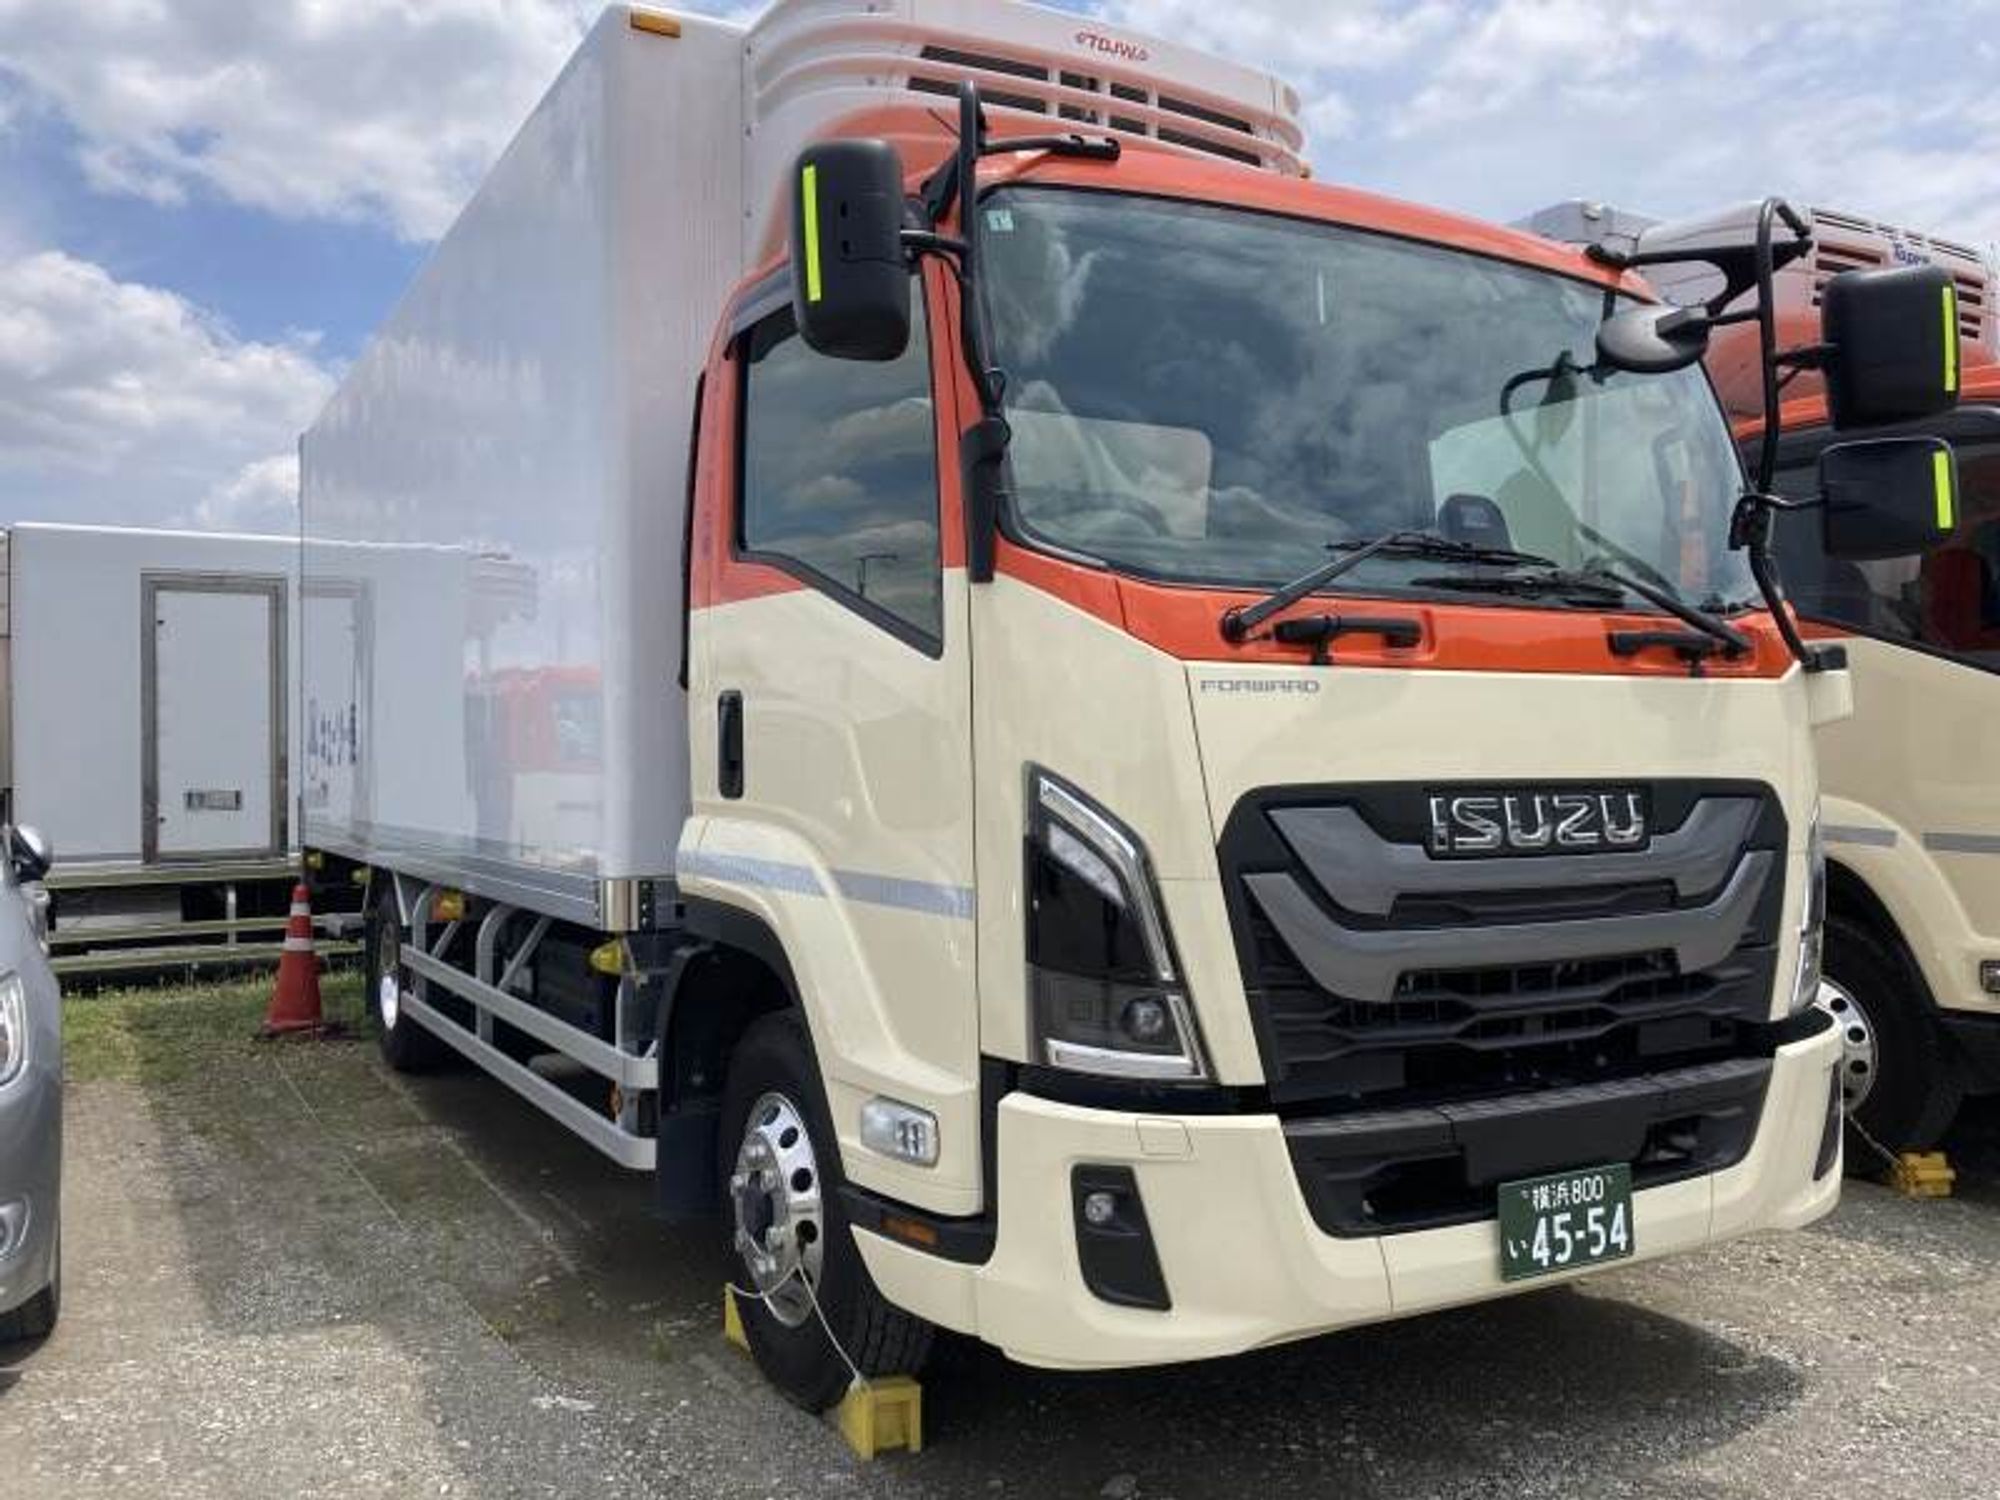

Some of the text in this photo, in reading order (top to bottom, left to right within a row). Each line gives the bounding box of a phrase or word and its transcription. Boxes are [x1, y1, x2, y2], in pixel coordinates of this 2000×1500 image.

[1200, 679, 1319, 693] FORWARD
[1429, 793, 1644, 850] ISUZU
[1531, 1202, 1628, 1266] 45-54
